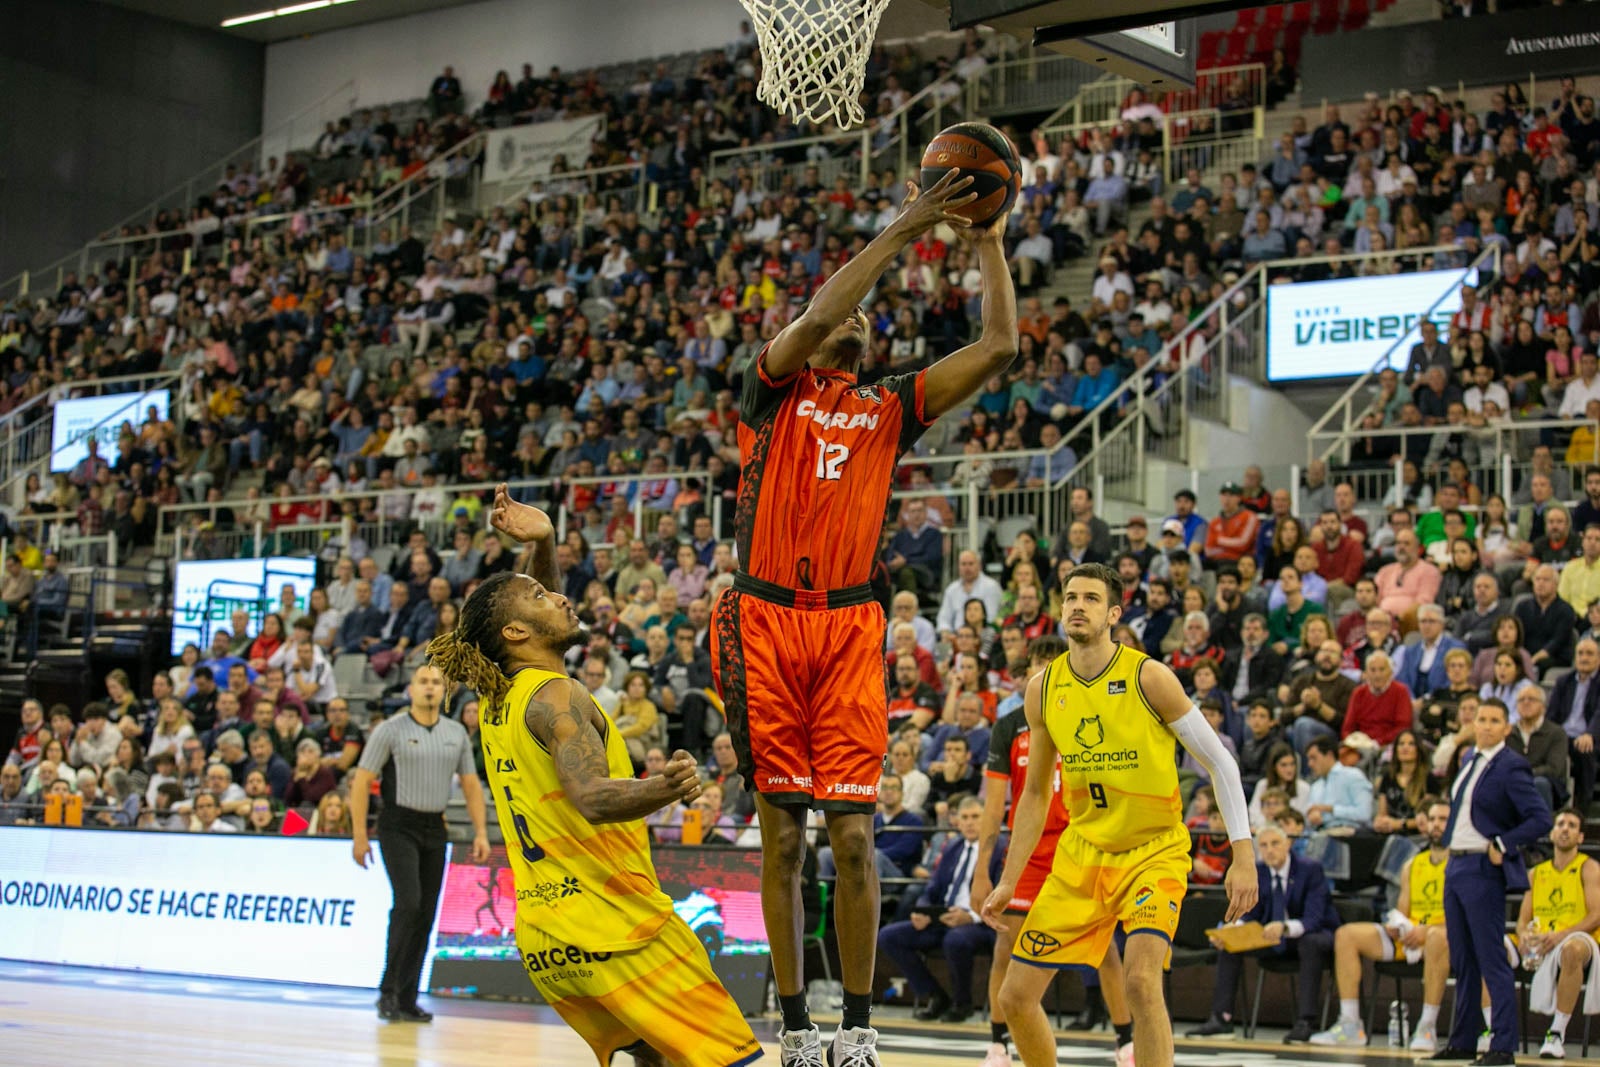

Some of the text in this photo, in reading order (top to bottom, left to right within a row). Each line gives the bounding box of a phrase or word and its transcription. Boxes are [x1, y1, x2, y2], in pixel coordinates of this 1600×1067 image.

[1295, 310, 1457, 346] Vialtera
[796, 399, 879, 431] CVIRAN
[815, 437, 850, 480] 12
[1061, 748, 1138, 764] ranCanaria
[1107, 762, 1139, 771] Deporte
[1089, 782, 1108, 808] 9
[127, 888, 154, 915] SE
[157, 889, 219, 919] HACE
[223, 893, 355, 927] REFERENTE
[540, 972, 566, 985] OTEL
